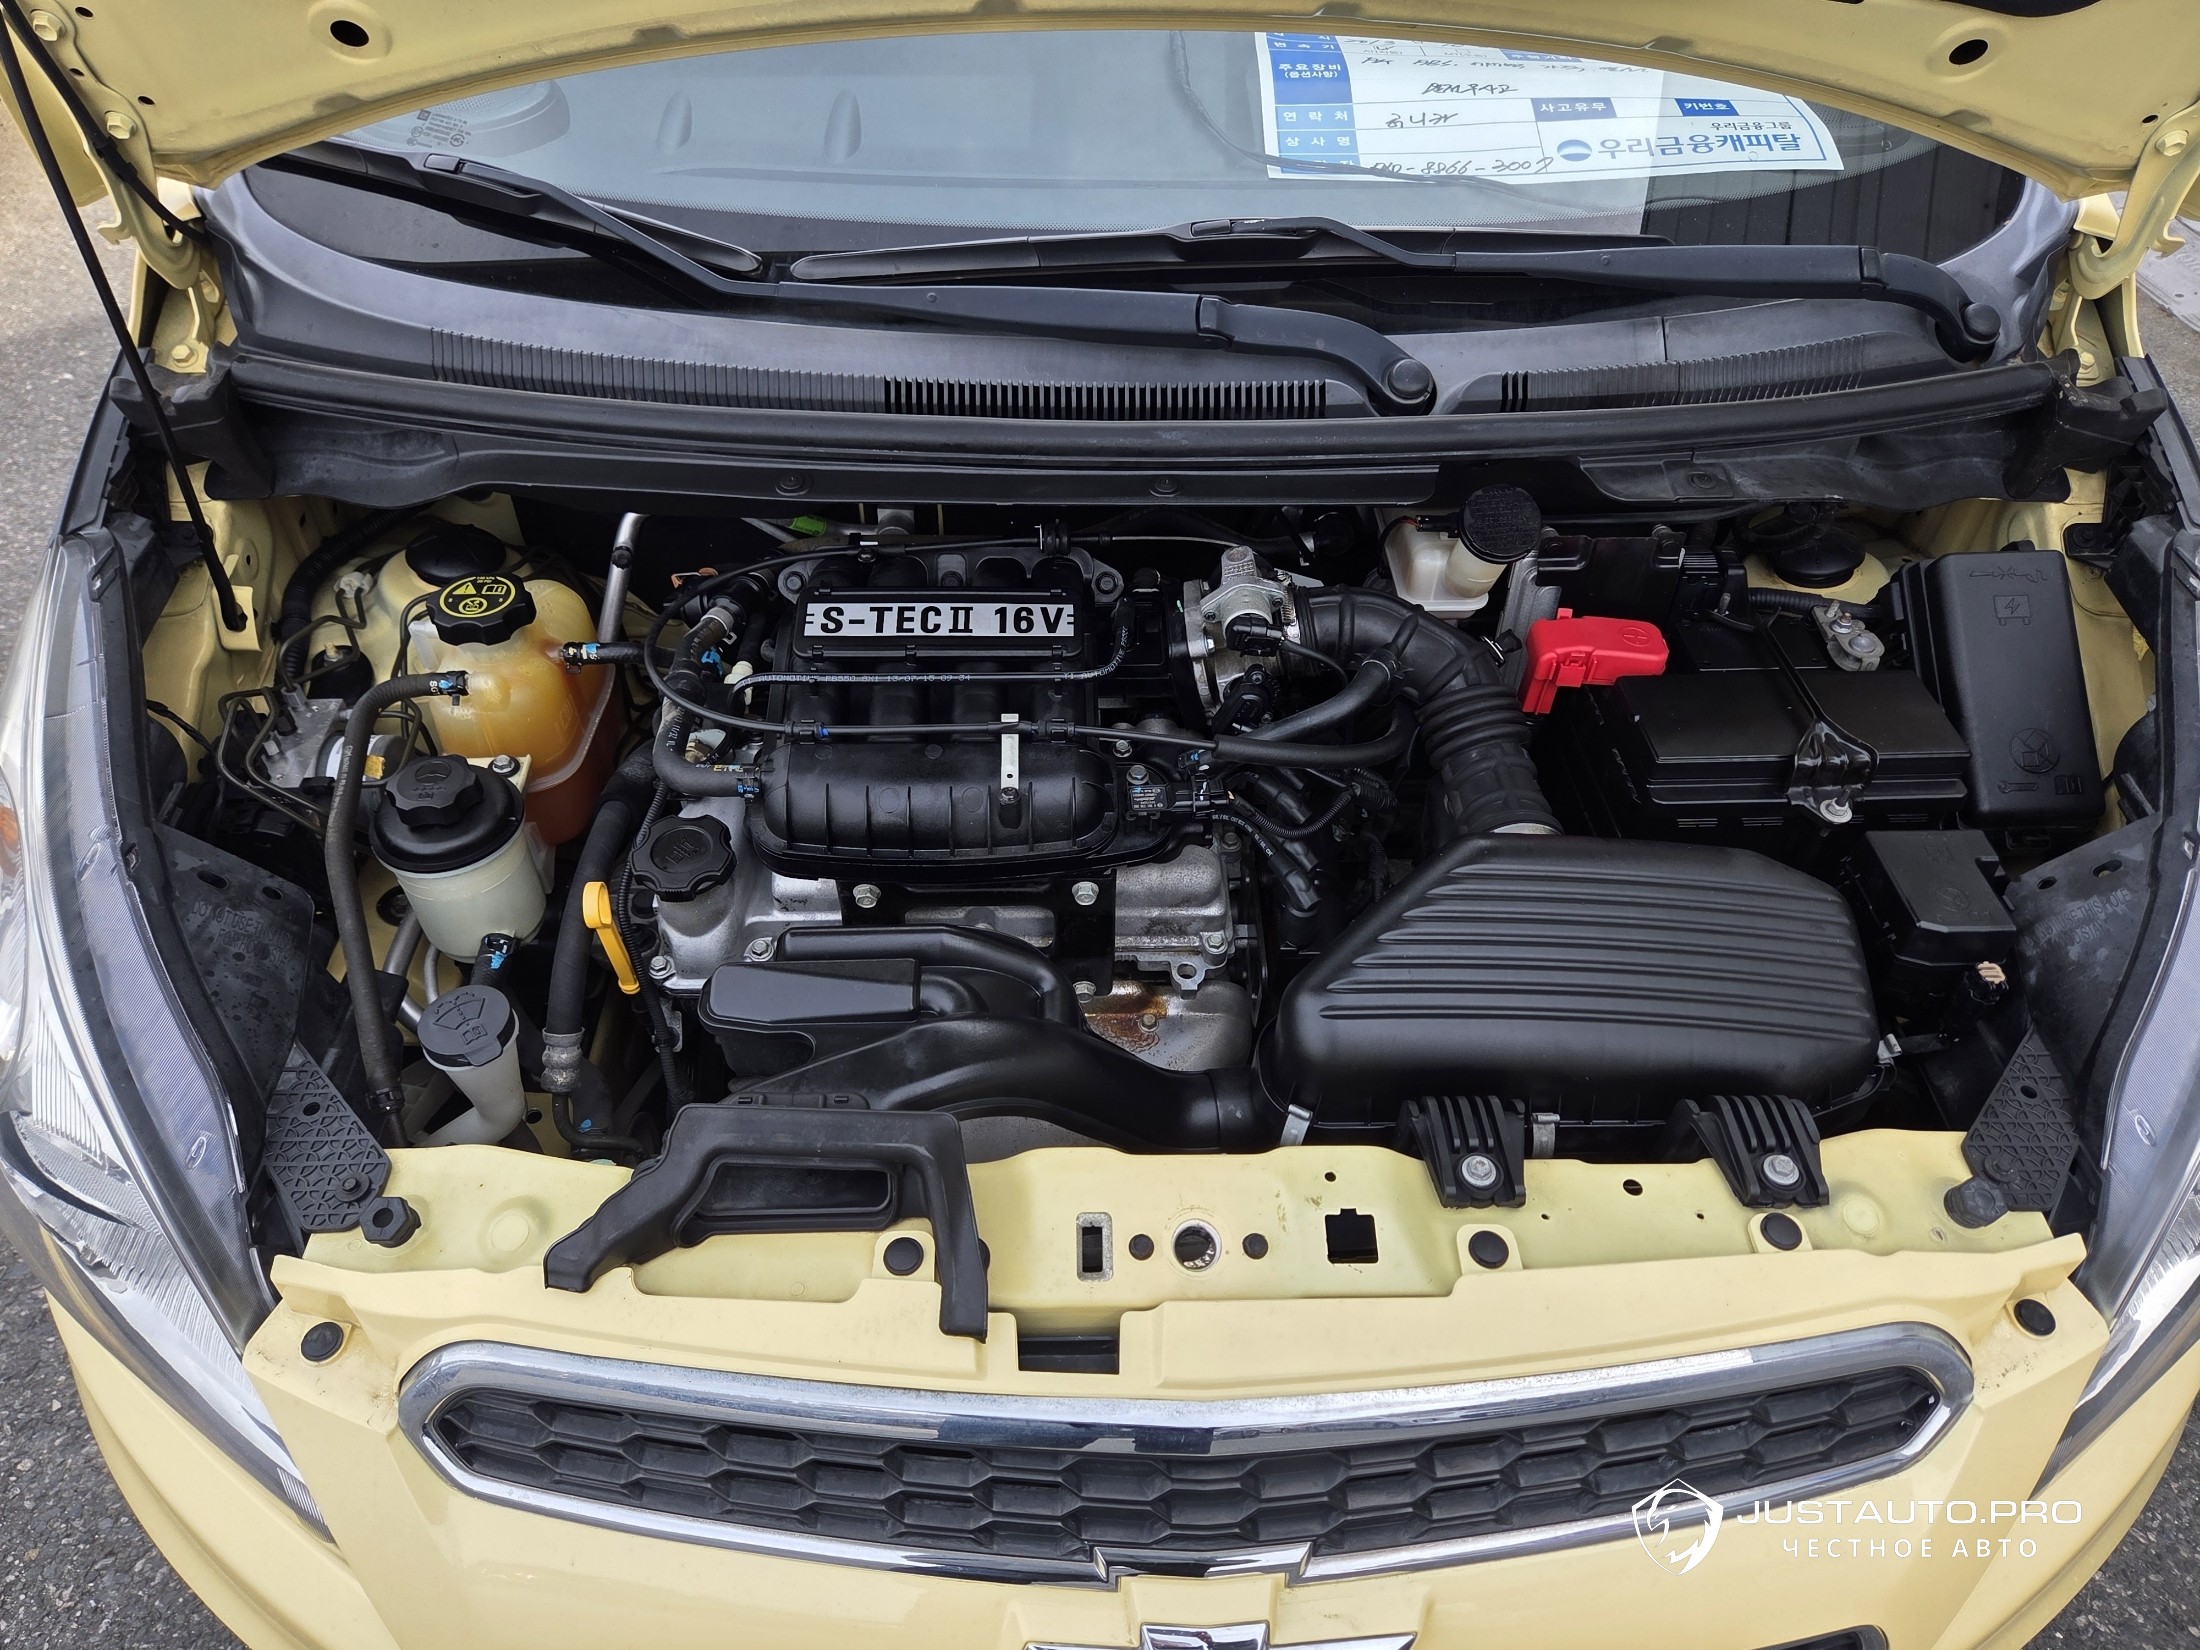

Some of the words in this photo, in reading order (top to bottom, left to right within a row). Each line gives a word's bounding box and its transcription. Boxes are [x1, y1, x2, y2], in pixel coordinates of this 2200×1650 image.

[1278, 63, 1342, 71] 주요장비
[1540, 101, 1607, 113] 사고유무
[1685, 101, 1730, 111] 키번호
[1710, 121, 1793, 131] 우리금융그룹
[1285, 136, 1351, 147] 상사명
[1598, 133, 1802, 160] 우리금융캐피탈
[994, 606, 1065, 634] 16V
